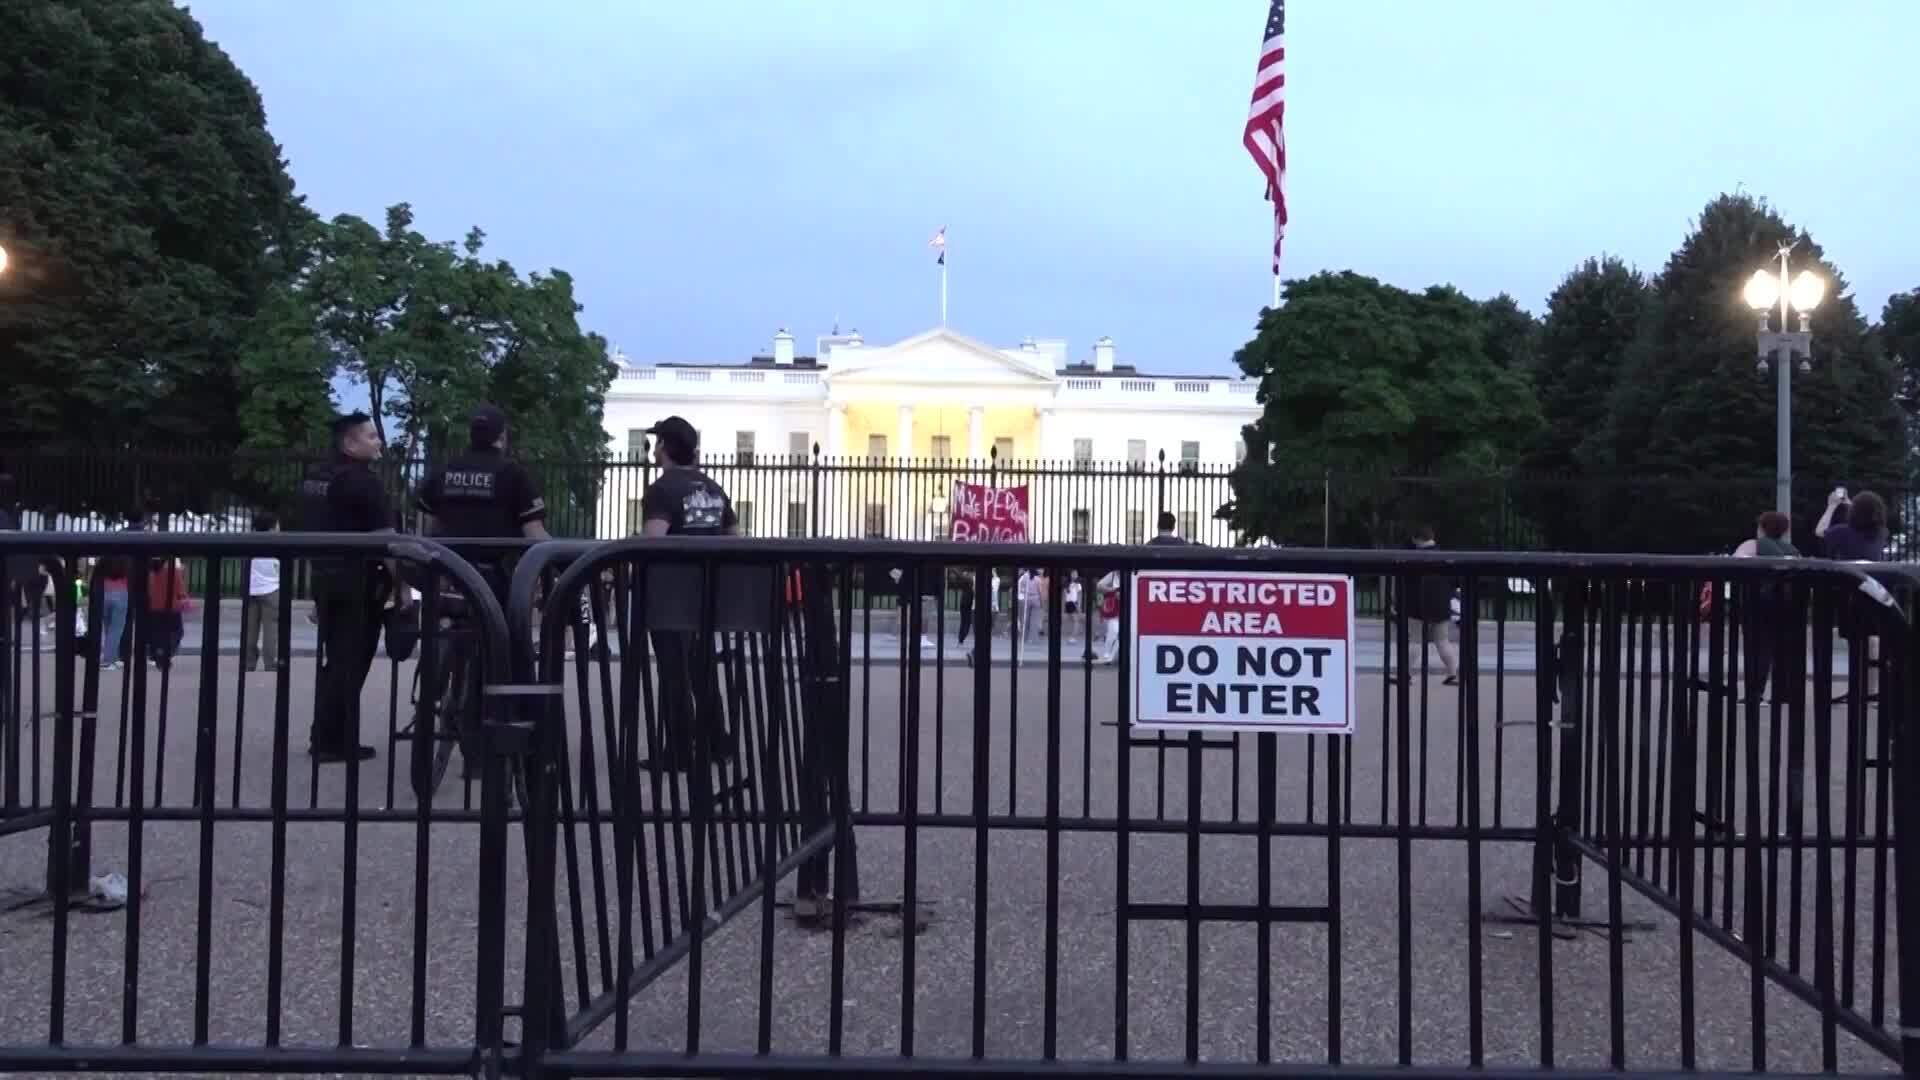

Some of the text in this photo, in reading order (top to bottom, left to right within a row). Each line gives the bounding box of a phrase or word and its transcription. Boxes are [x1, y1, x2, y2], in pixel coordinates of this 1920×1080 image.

[444, 472, 491, 488] POLICE
[1148, 581, 1336, 607] RESTRICTED
[1200, 611, 1284, 634] AREA
[1155, 644, 1332, 678] DO NOT
[1166, 683, 1321, 716] ENTER
